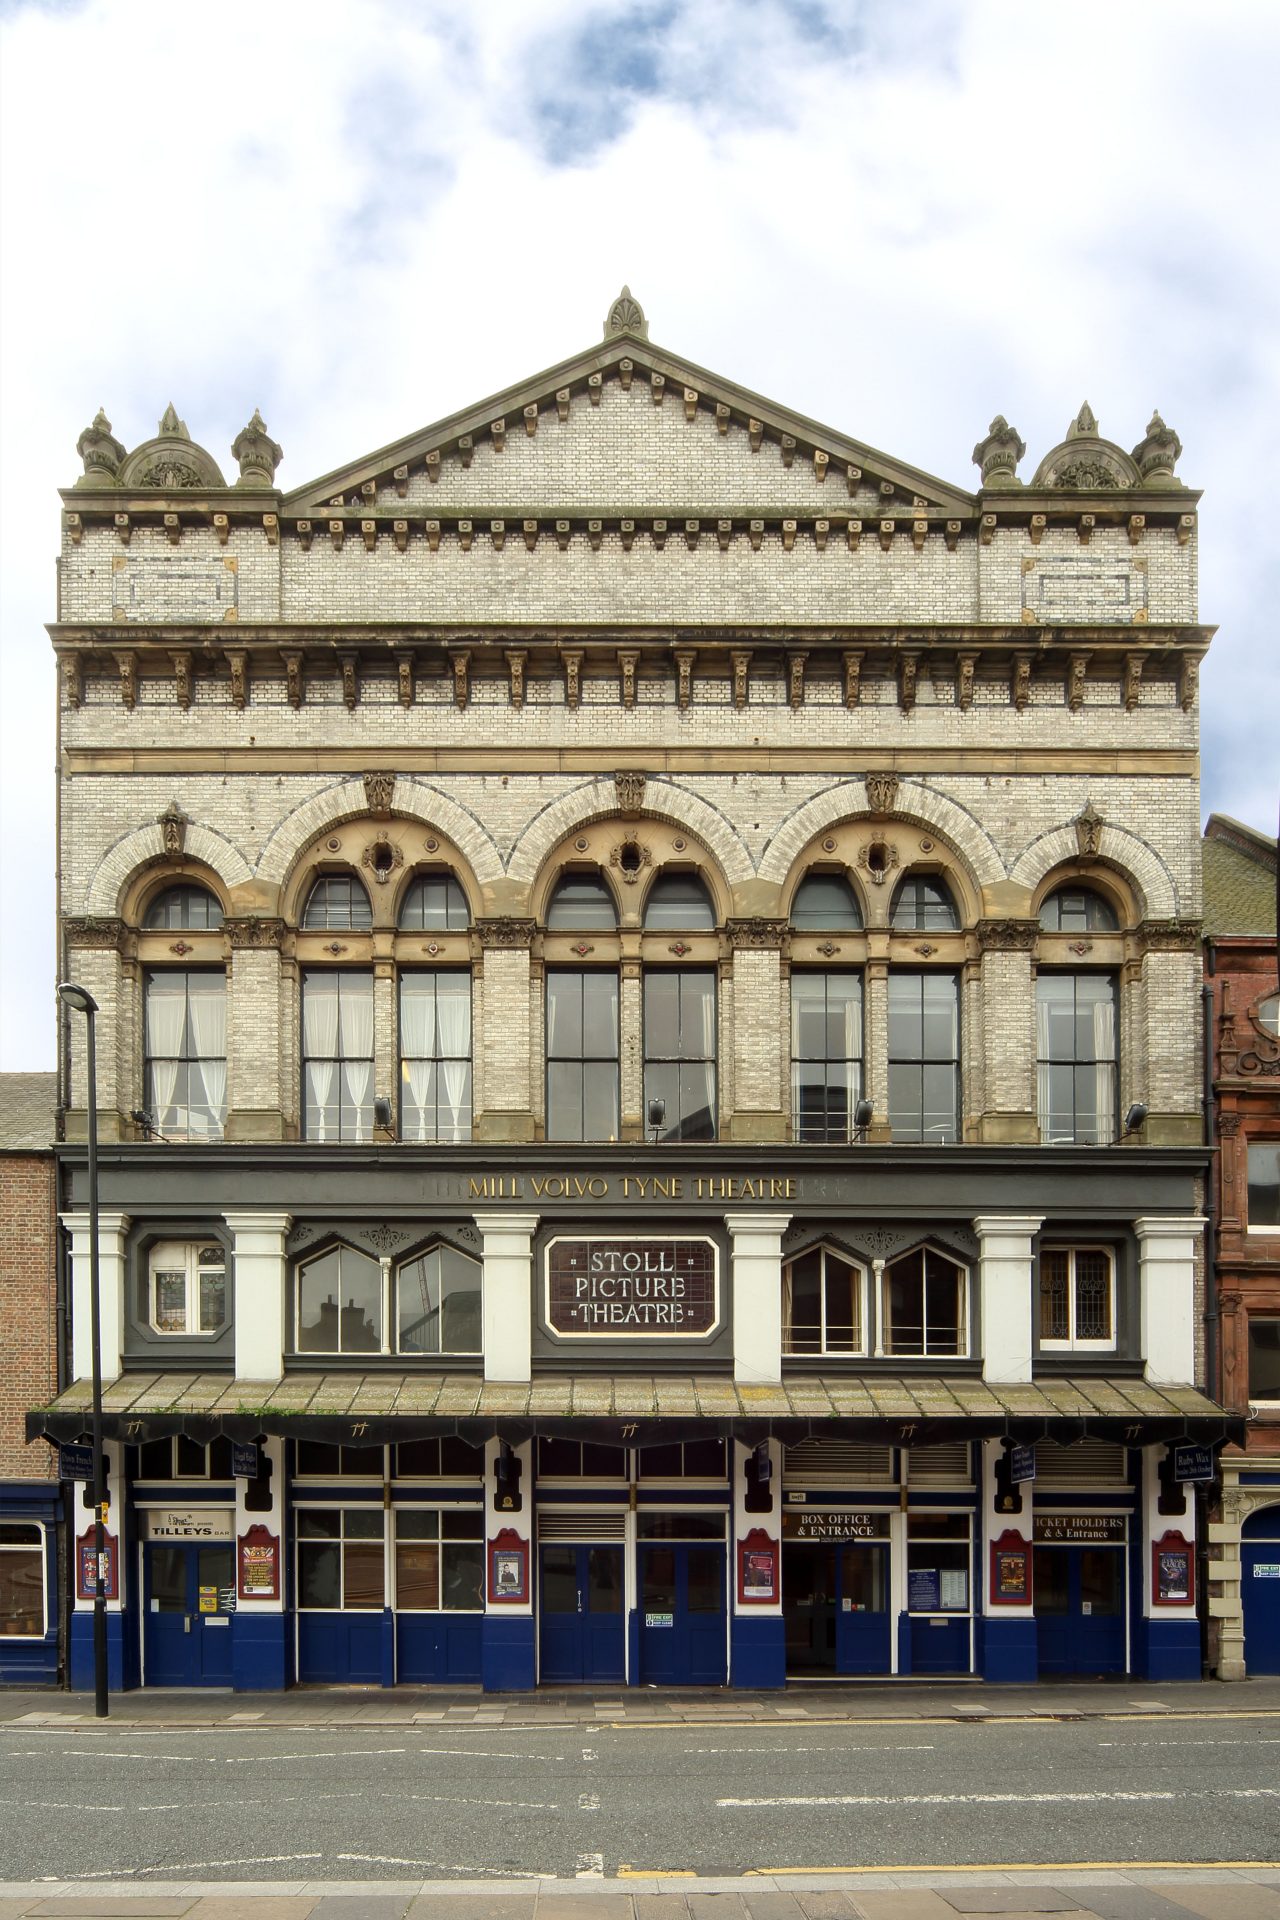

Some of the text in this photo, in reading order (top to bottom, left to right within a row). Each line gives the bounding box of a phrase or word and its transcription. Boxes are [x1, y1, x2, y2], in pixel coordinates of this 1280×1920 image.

[468, 1177, 523, 1198] MILL
[531, 1177, 609, 1198] VOLVO
[619, 1177, 682, 1198] TYNE
[693, 1178, 797, 1199] THEATRE
[591, 1252, 674, 1272] STOLL
[575, 1277, 686, 1298] PICTURE
[578, 1303, 684, 1323] THEATRE
[1178, 1452, 1209, 1466] Ruby Wax
[801, 1514, 871, 1525] BOX OFFICE
[1072, 1518, 1124, 1528] HOLDERS
[797, 1526, 874, 1536] & ENTRANCE
[1044, 1528, 1109, 1539] & Entrance
